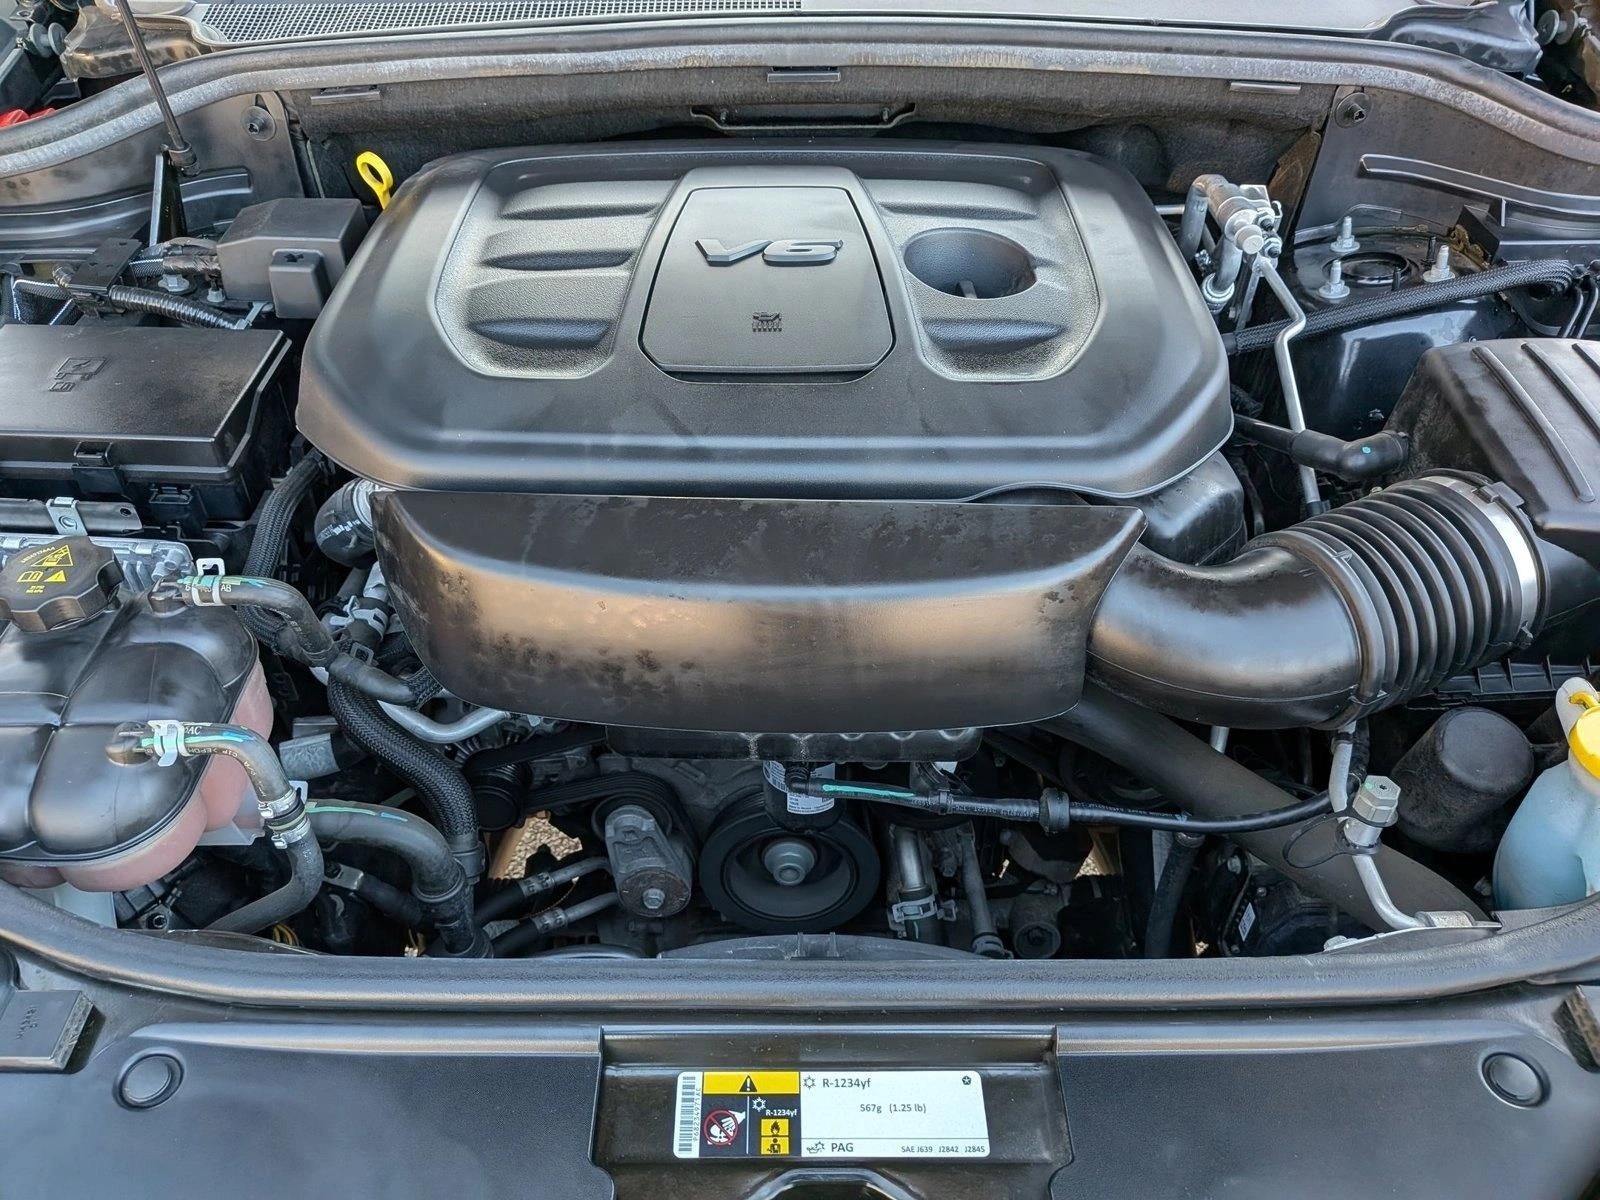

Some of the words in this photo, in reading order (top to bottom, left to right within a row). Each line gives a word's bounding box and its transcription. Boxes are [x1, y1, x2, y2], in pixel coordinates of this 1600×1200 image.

[695, 239, 843, 267] V6
[822, 1078, 871, 1089] R-1234yf
[765, 1108, 798, 1117] R-1234yf
[860, 1103, 882, 1114] 567g
[889, 1103, 912, 1114] (1.25
[914, 1103, 927, 1114] lb)
[831, 1143, 854, 1152] PAG
[901, 1145, 915, 1153] SAE
[917, 1145, 933, 1153] J639
[938, 1145, 959, 1153] J2842
[964, 1145, 985, 1153] J2845
